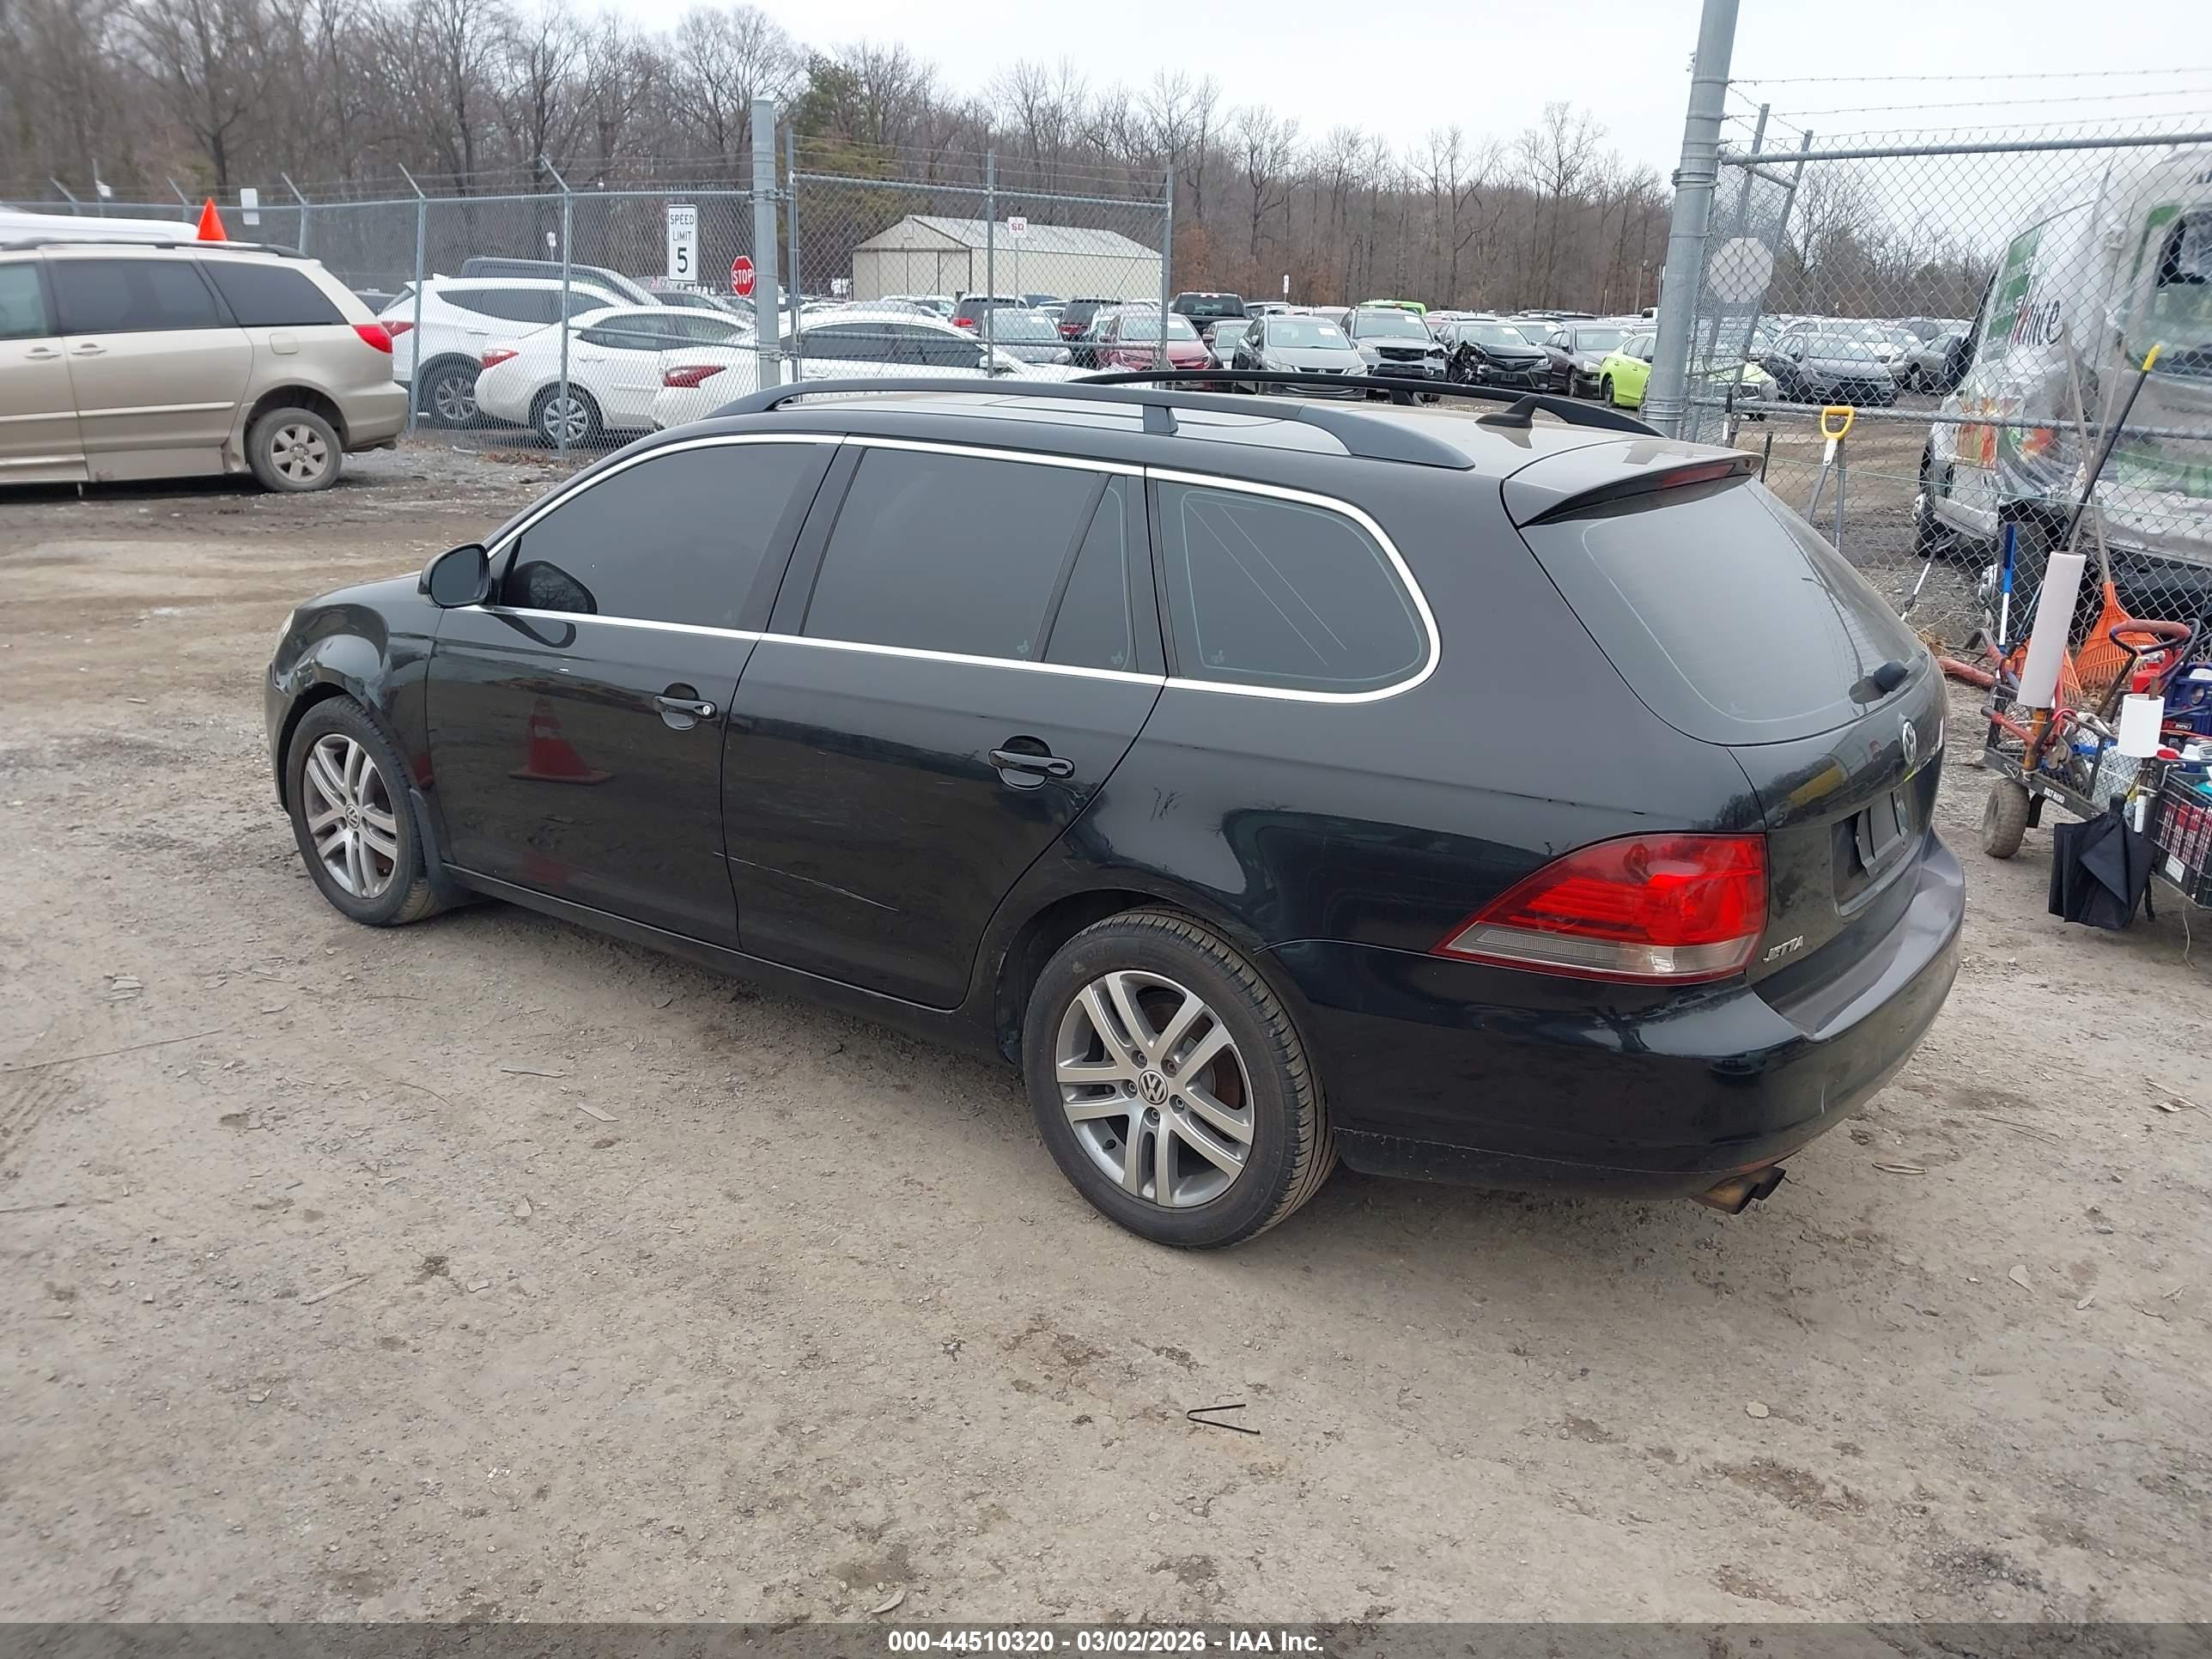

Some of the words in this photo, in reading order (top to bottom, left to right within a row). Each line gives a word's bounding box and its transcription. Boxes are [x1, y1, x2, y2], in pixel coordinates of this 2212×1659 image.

[670, 214, 695, 225] SPEED
[672, 231, 692, 241] LIMIT
[677, 247, 688, 273] 5
[732, 269, 753, 284] STOP
[1762, 934, 1804, 963] JETTA
